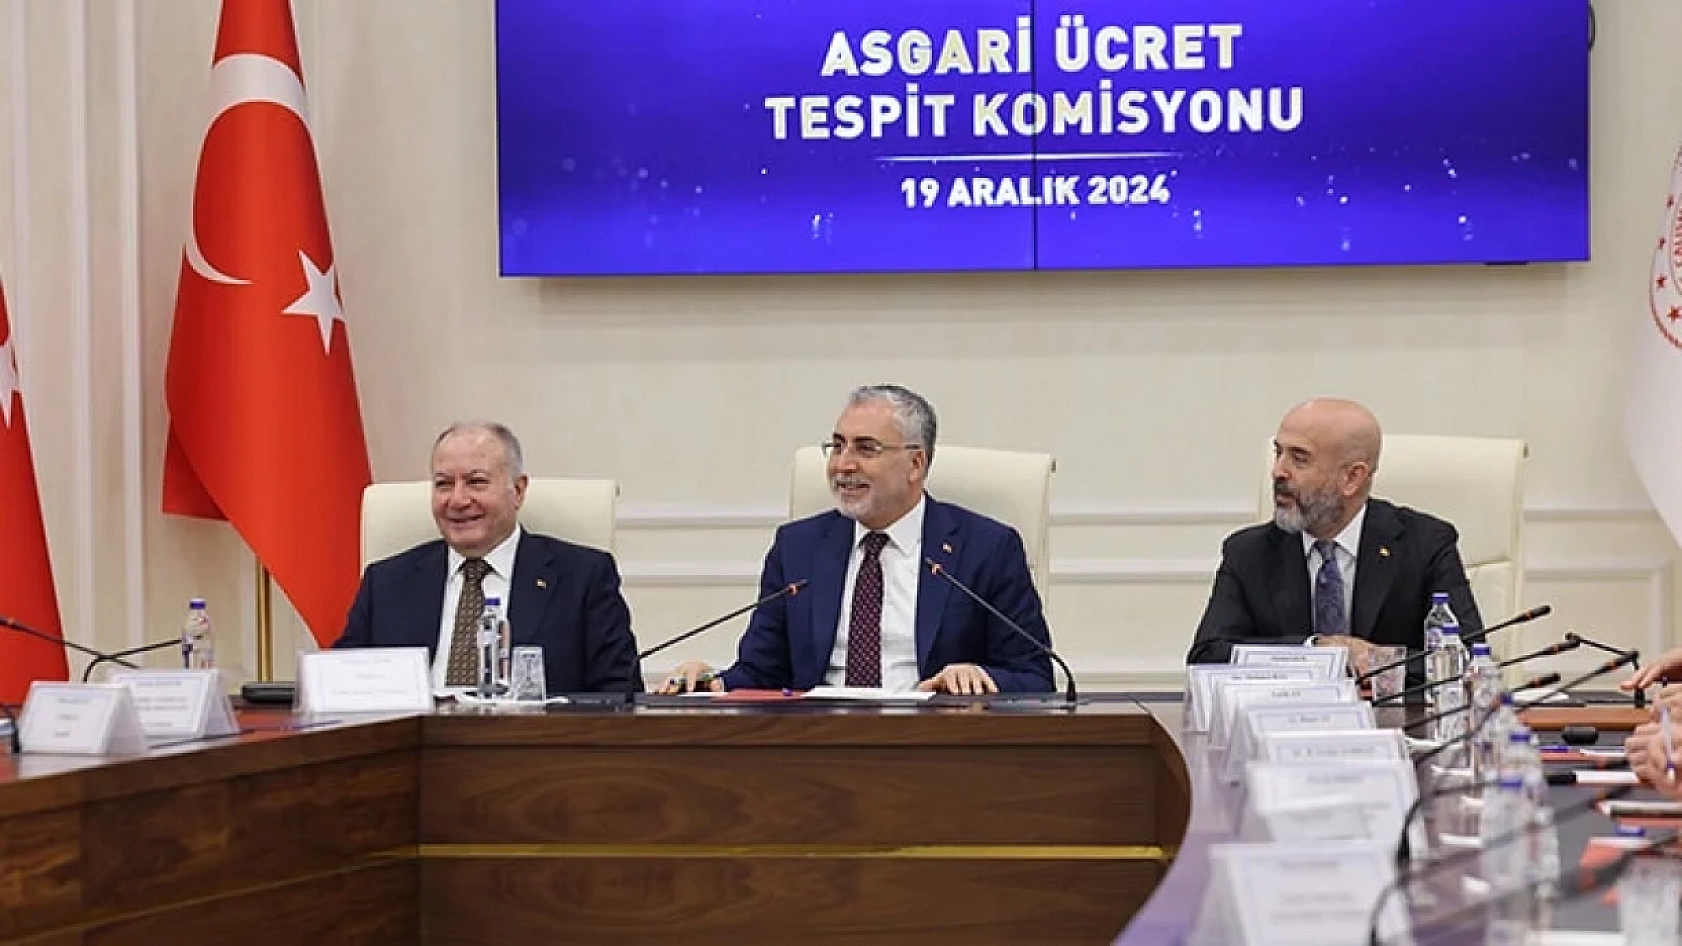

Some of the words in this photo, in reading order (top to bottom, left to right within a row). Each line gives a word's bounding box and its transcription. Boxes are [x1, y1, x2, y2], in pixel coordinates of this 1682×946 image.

[821, 16, 1030, 76] ASGARİ
[1056, 16, 1242, 72] ÜCRET
[765, 84, 954, 139] TESPİT
[973, 80, 1303, 136] KOMİSYONU
[902, 178, 939, 208] 19
[947, 176, 1080, 207] ARALIK
[1088, 174, 1168, 204] 2024
